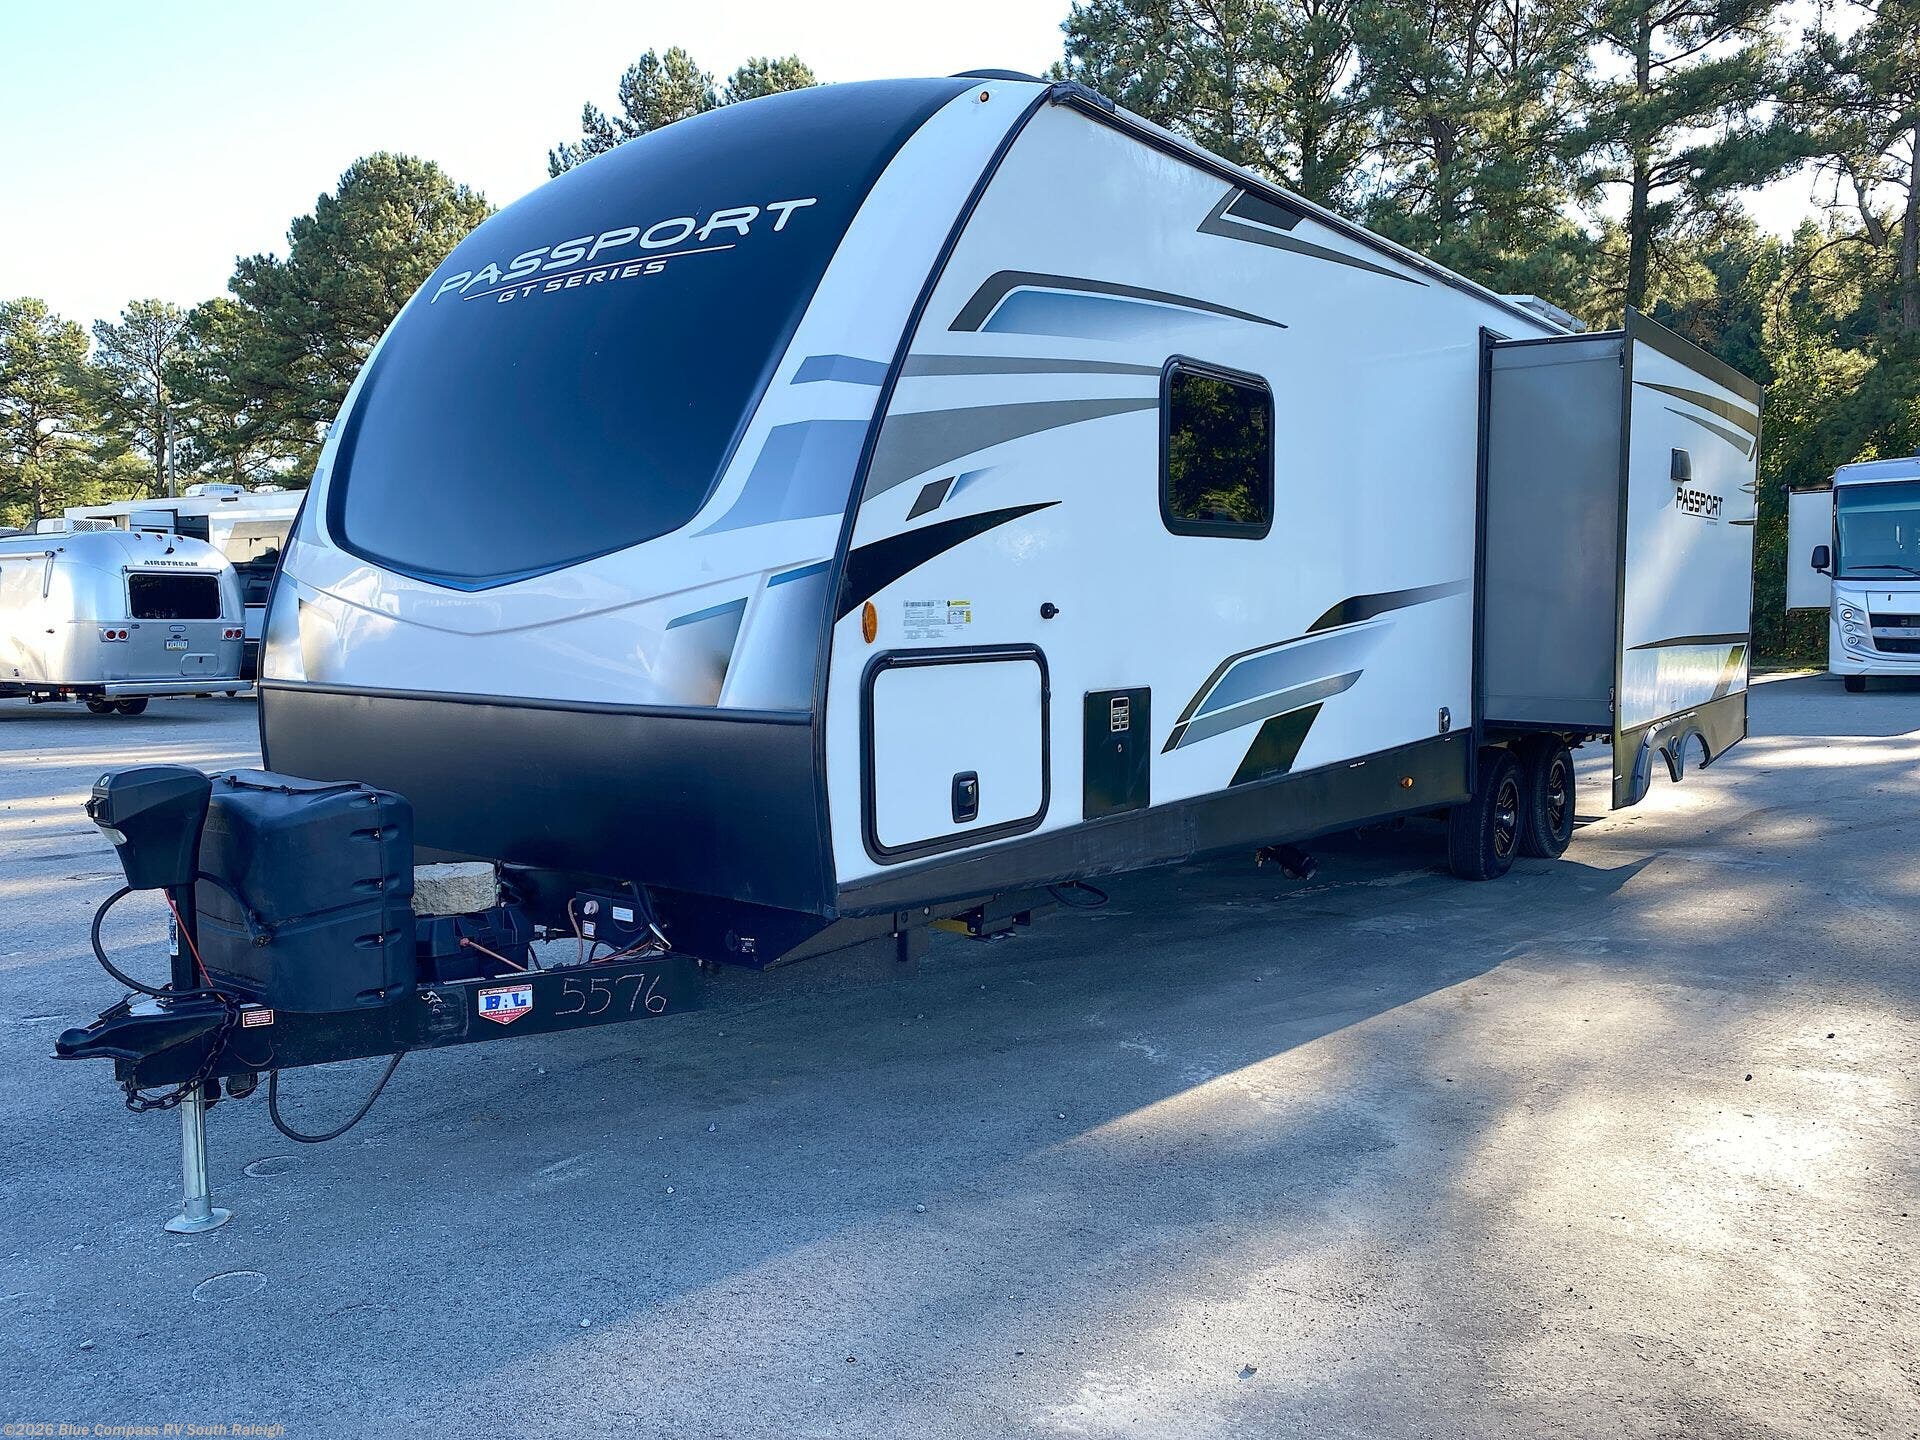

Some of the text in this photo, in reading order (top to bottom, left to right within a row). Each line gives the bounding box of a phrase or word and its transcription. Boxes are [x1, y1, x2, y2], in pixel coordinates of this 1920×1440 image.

[431, 196, 818, 305] PASSPORT
[496, 259, 667, 304] GT SERIES
[1675, 486, 1724, 517] PASSPORT
[143, 559, 199, 567] AIRSTREAM
[485, 992, 527, 1011] BAL
[554, 973, 668, 1014] 5576
